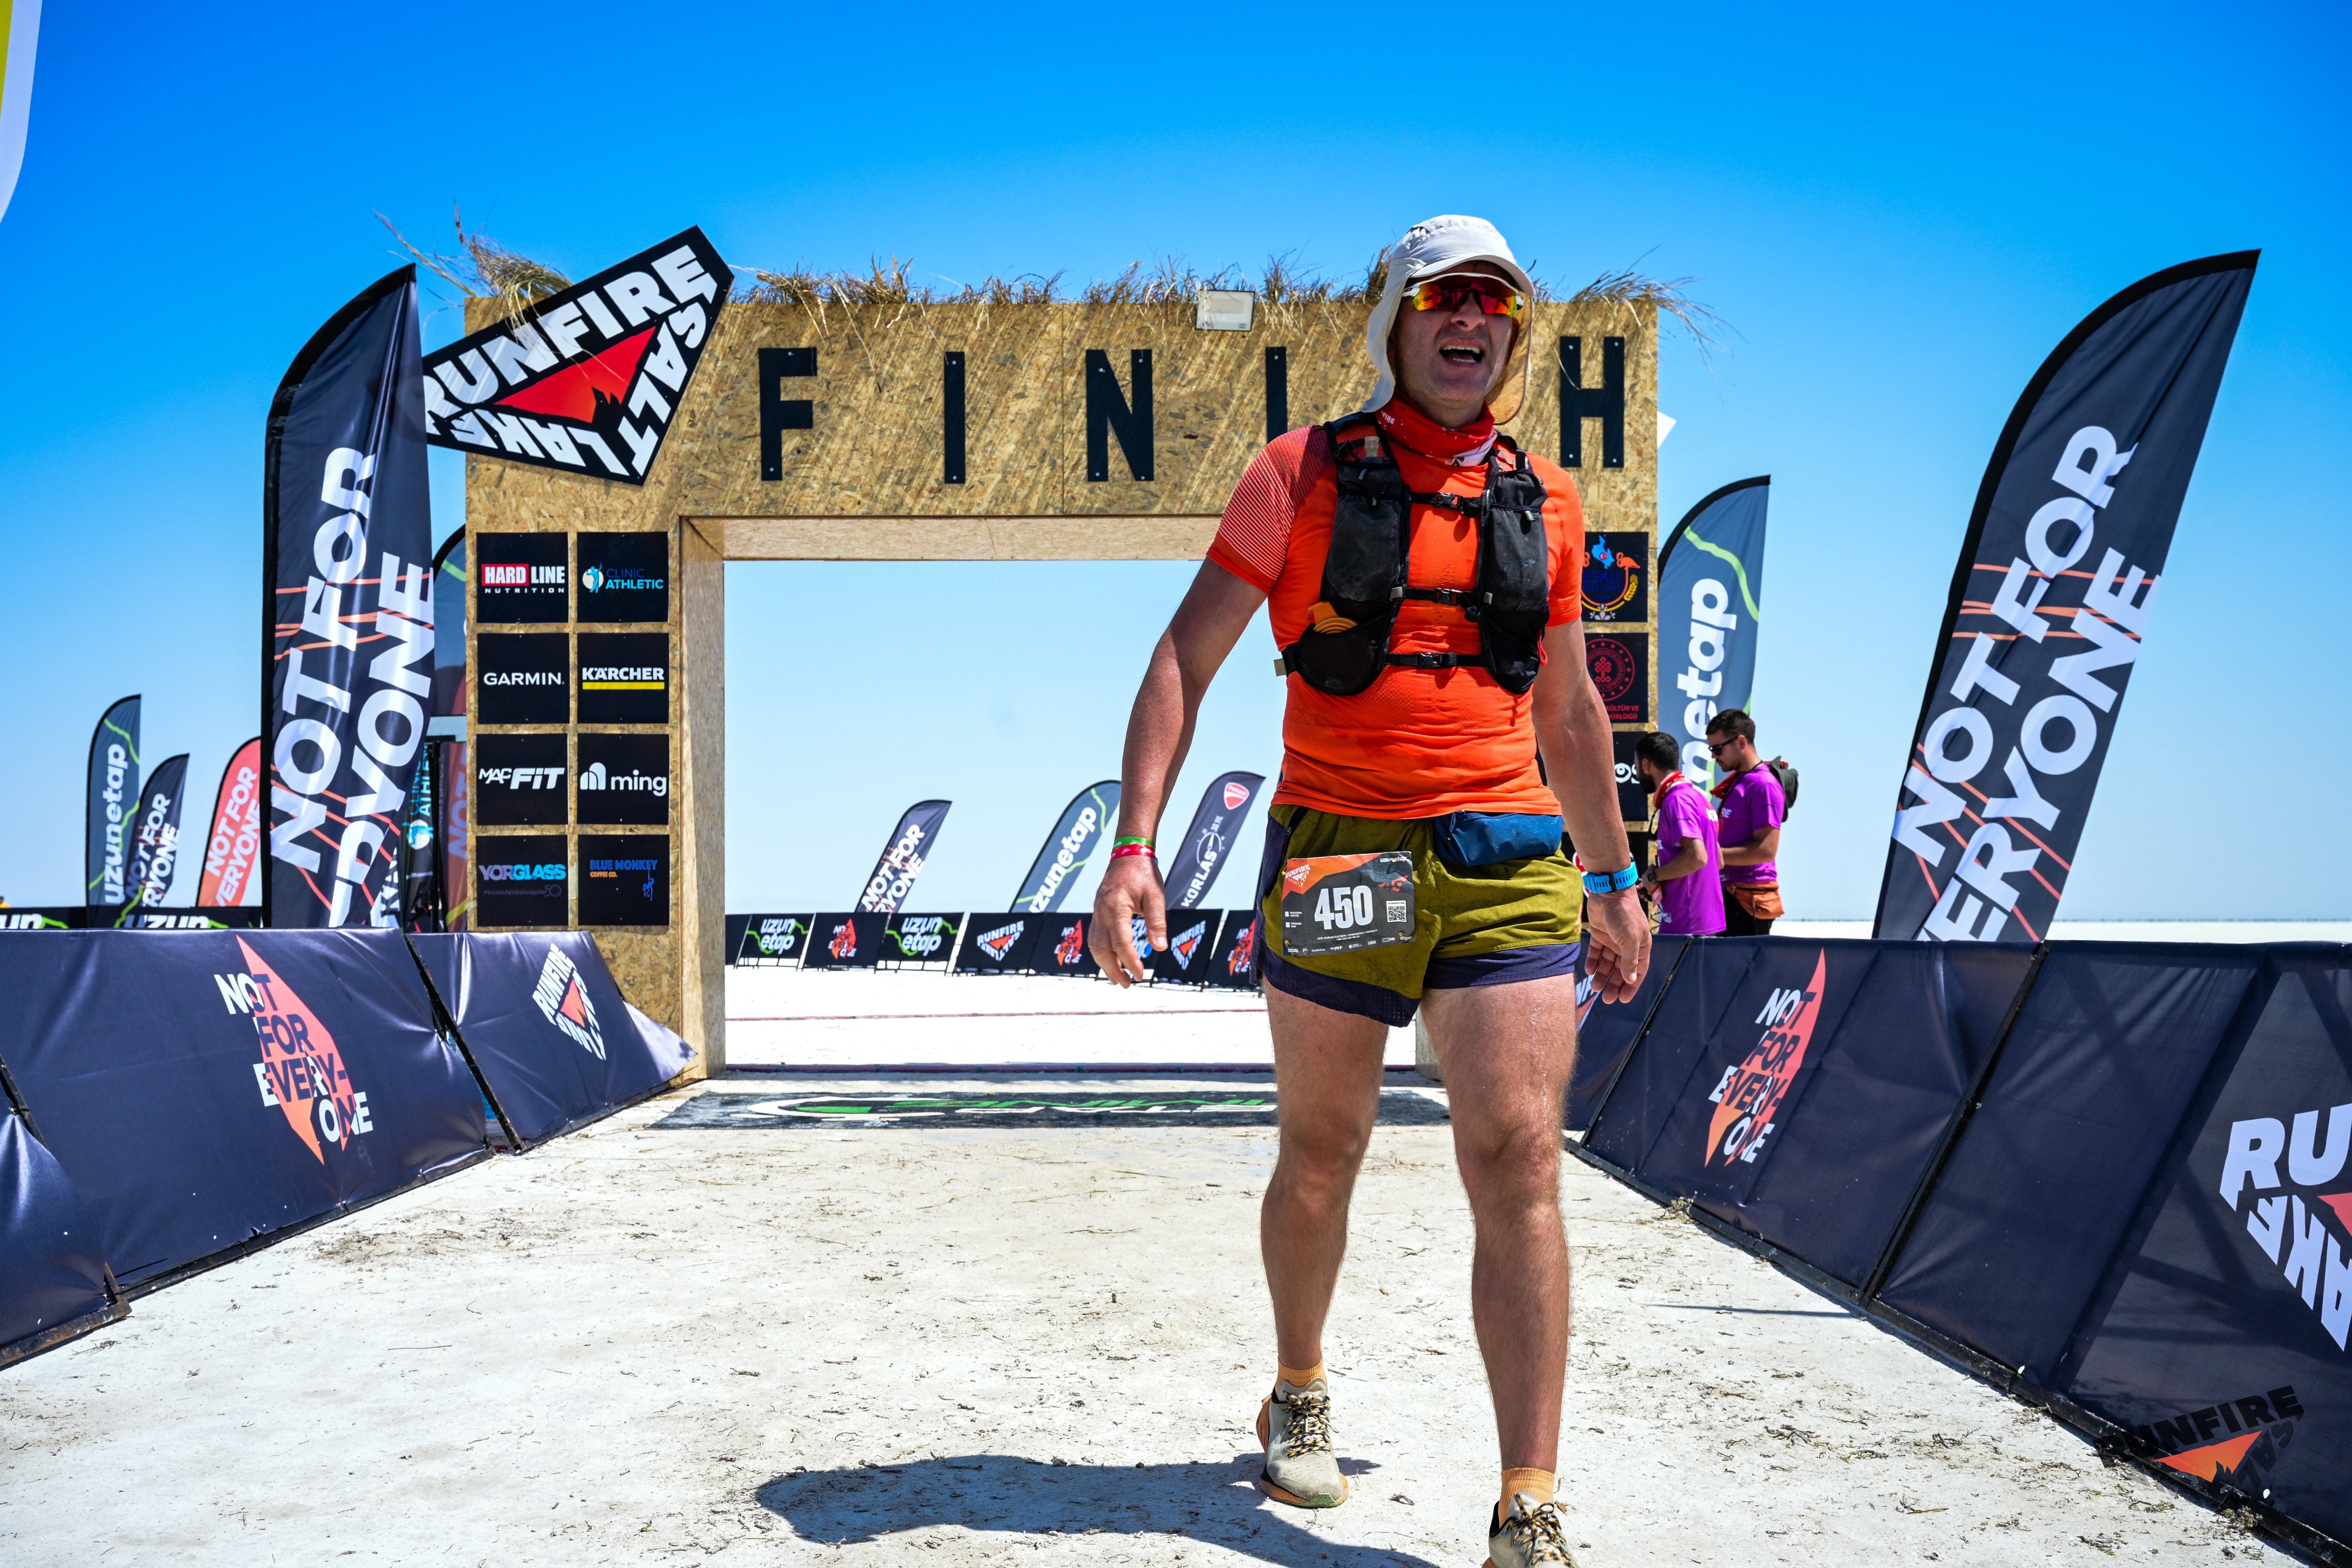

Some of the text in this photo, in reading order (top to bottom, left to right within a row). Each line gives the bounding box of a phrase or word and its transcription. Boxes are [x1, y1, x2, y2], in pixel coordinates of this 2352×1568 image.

[423, 244, 718, 436] RUNFIRE
[450, 301, 707, 477] SALT LAKE
[759, 336, 1625, 485] FINIH
[485, 566, 565, 584] HARD LINE
[606, 579, 664, 589] ATHLETIC
[607, 569, 644, 578] CLINIC
[270, 447, 376, 873] NOT FOR
[1891, 425, 2138, 866] NOT FOR
[583, 667, 665, 680] KÄRCHER
[479, 768, 512, 784] MAC
[611, 769, 667, 796] ming
[103, 744, 128, 904] uzunetap
[205, 766, 258, 877] NOT FOR
[125, 793, 171, 900] NOT FOR
[590, 859, 658, 870] BLUE MONKEY
[861, 824, 925, 910] NOT FOR
[478, 864, 567, 881] YORGLASS
[1181, 850, 1217, 907] KORLAS
[1285, 864, 1311, 879] RUNFIRE
[760, 918, 796, 934] uzun
[901, 917, 943, 933] uzun
[1314, 885, 1373, 930] 450
[760, 933, 795, 954] etap
[833, 925, 850, 934] NOT
[902, 932, 942, 956] etap
[977, 920, 1024, 947] RUNFIRE
[1171, 920, 1206, 951] RUNFIRE
[214, 973, 278, 1015] NOT
[532, 943, 578, 1026] RUNFIRE
[1755, 988, 1817, 1030] NOT
[252, 1013, 316, 1058] FOR
[1745, 1030, 1801, 1073] FOR
[318, 1091, 373, 1143] ONE
[1724, 1116, 1775, 1164] ONE
